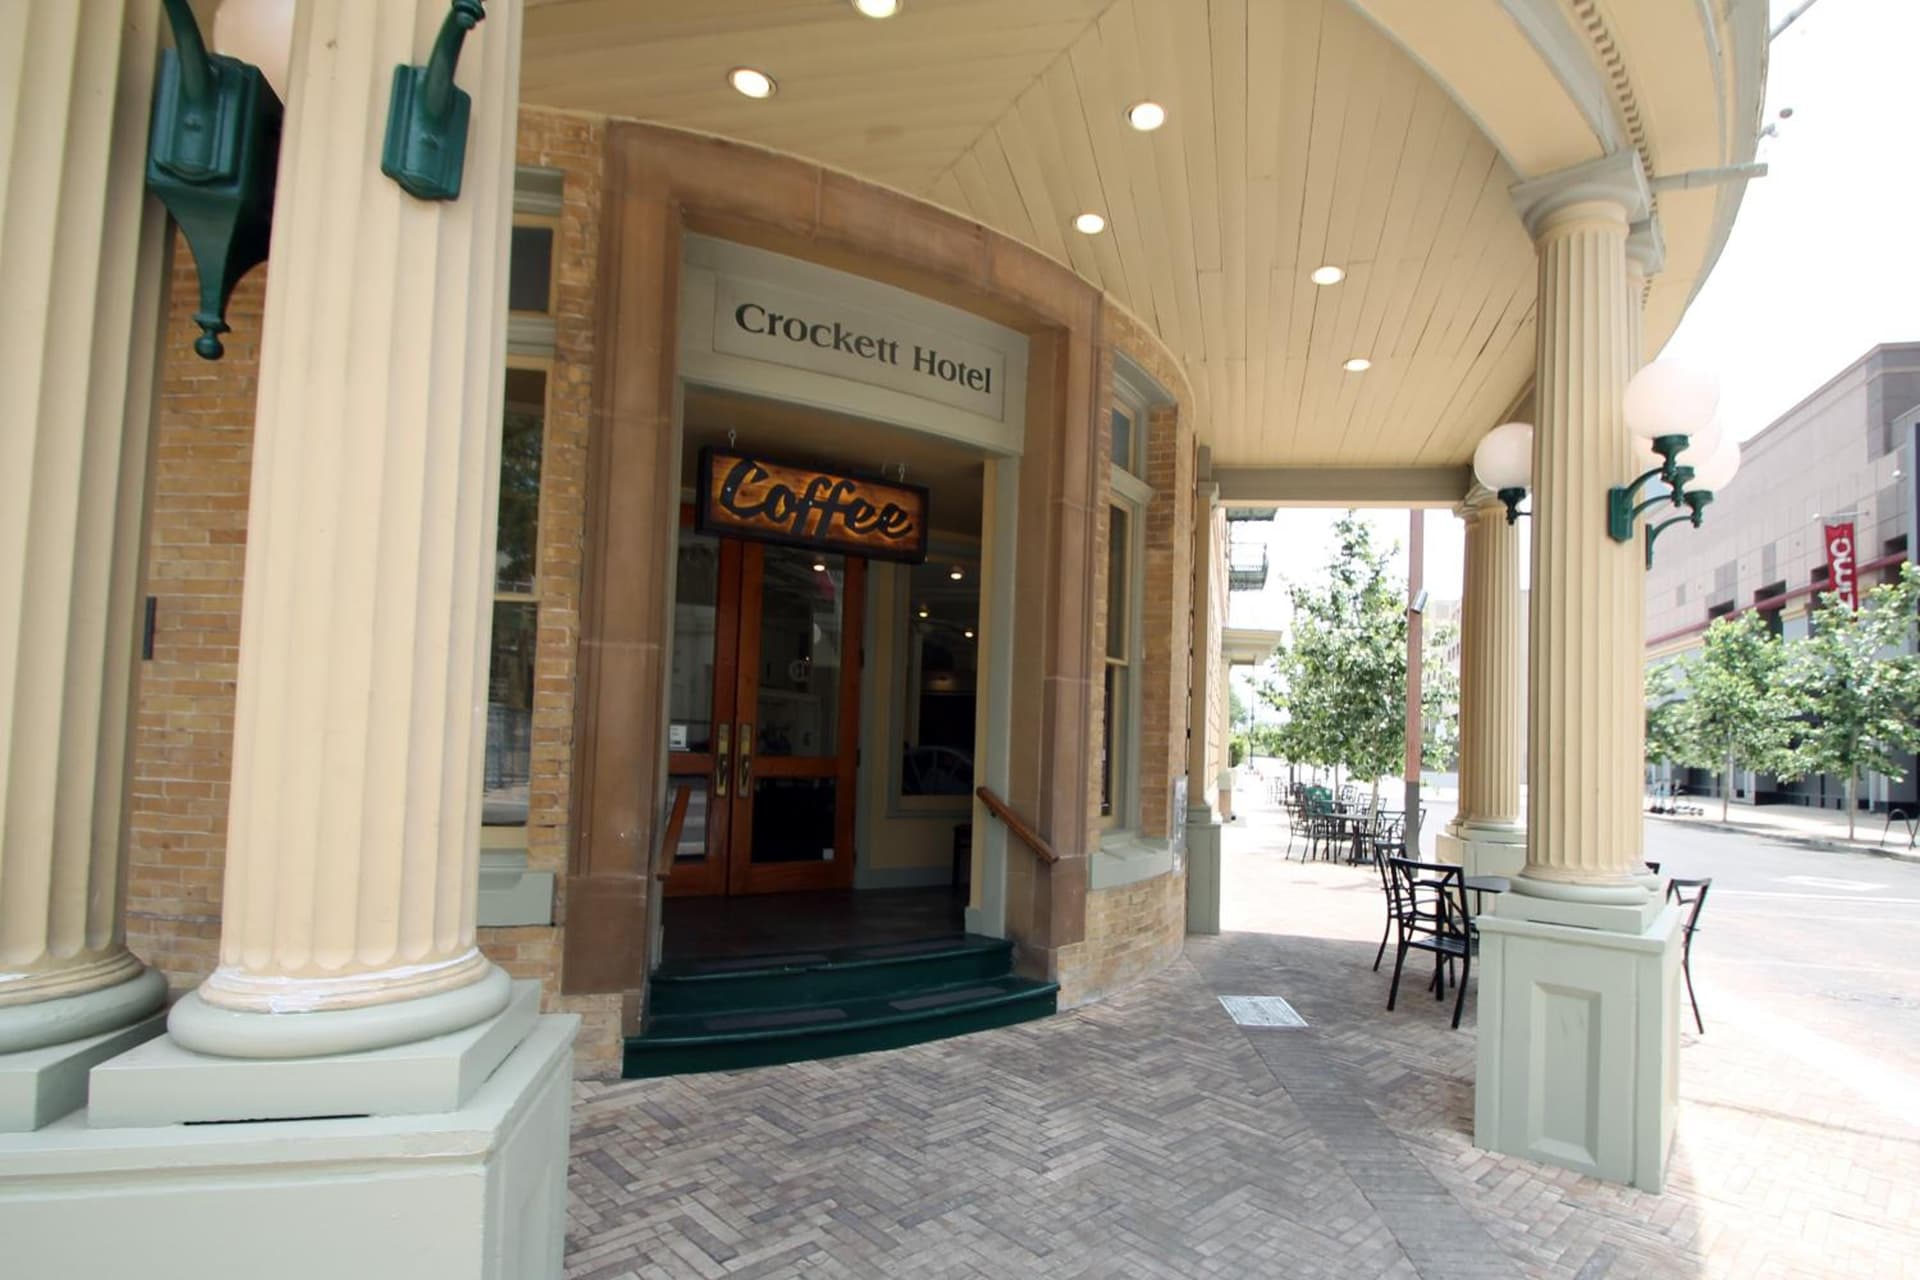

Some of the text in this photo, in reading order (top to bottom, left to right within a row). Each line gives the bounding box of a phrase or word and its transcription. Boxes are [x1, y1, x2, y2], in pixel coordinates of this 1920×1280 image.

[735, 303, 992, 394] Crockett Hotel
[720, 458, 912, 538] Coffee
